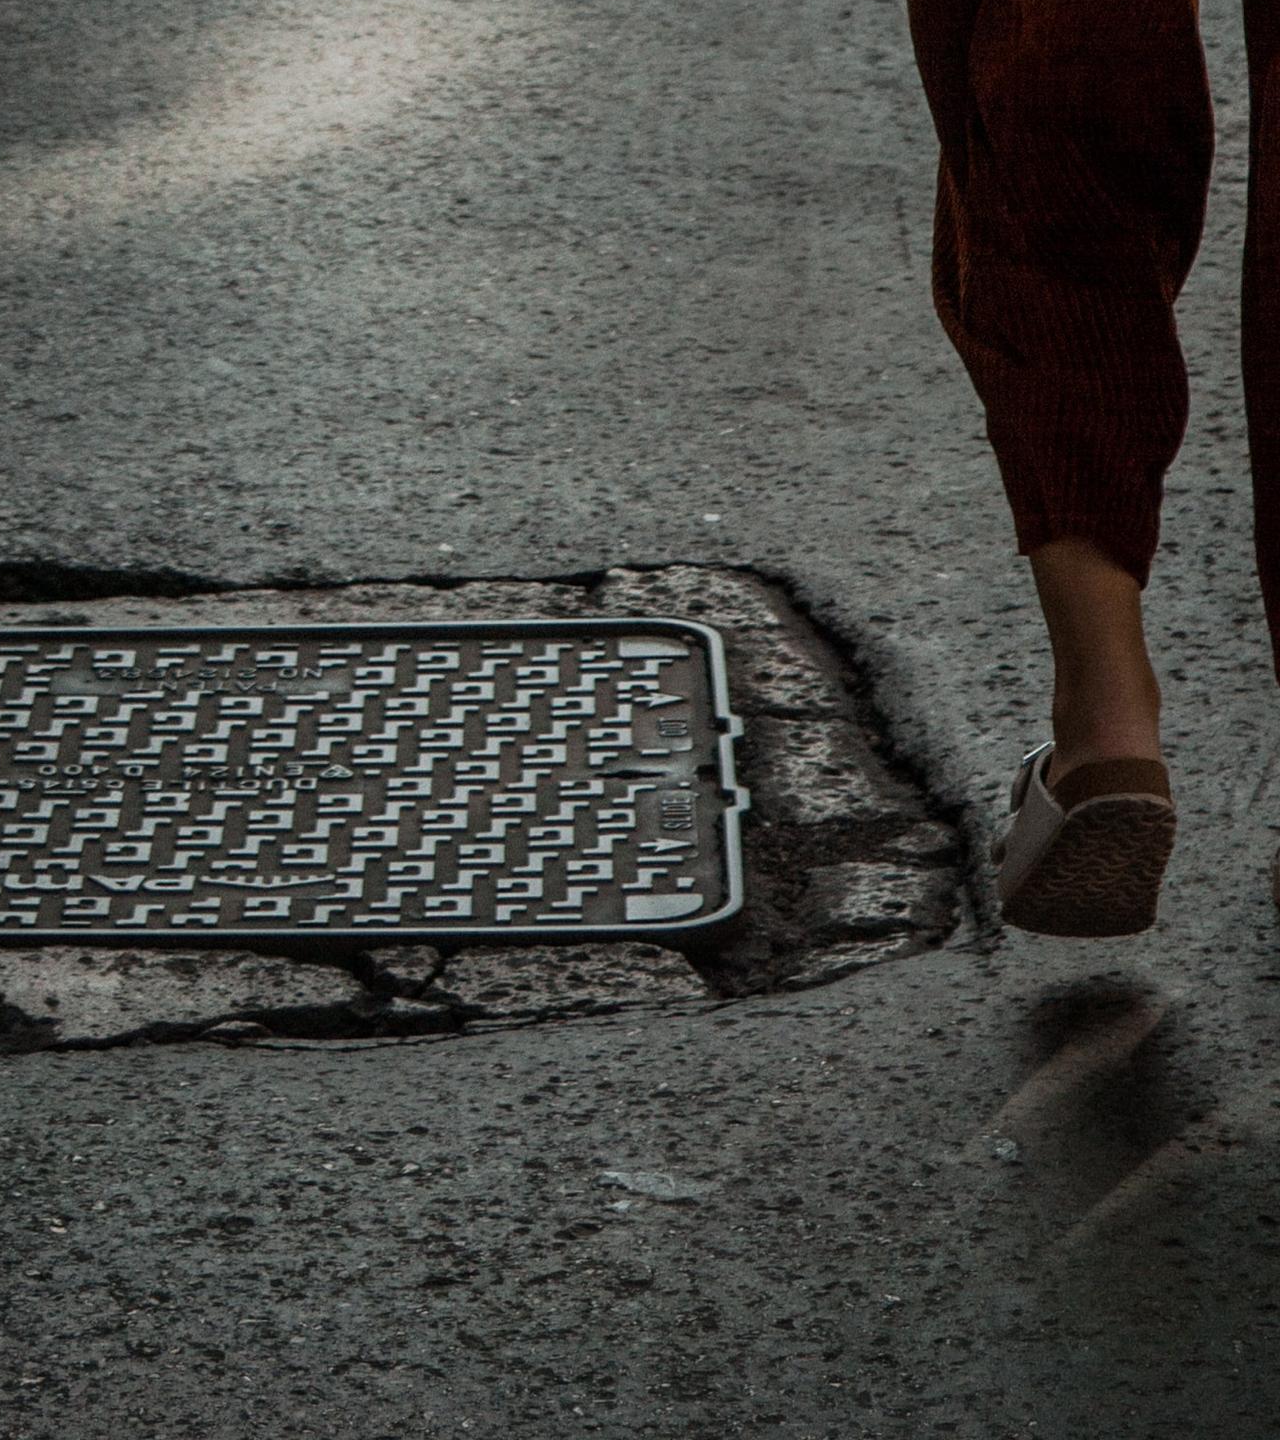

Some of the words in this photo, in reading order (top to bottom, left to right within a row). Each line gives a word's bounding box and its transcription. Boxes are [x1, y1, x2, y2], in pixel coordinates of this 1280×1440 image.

[137, 680, 278, 692] PATENT
[140, 779, 319, 791] DUCTILE
[661, 798, 693, 830] SLIDE
